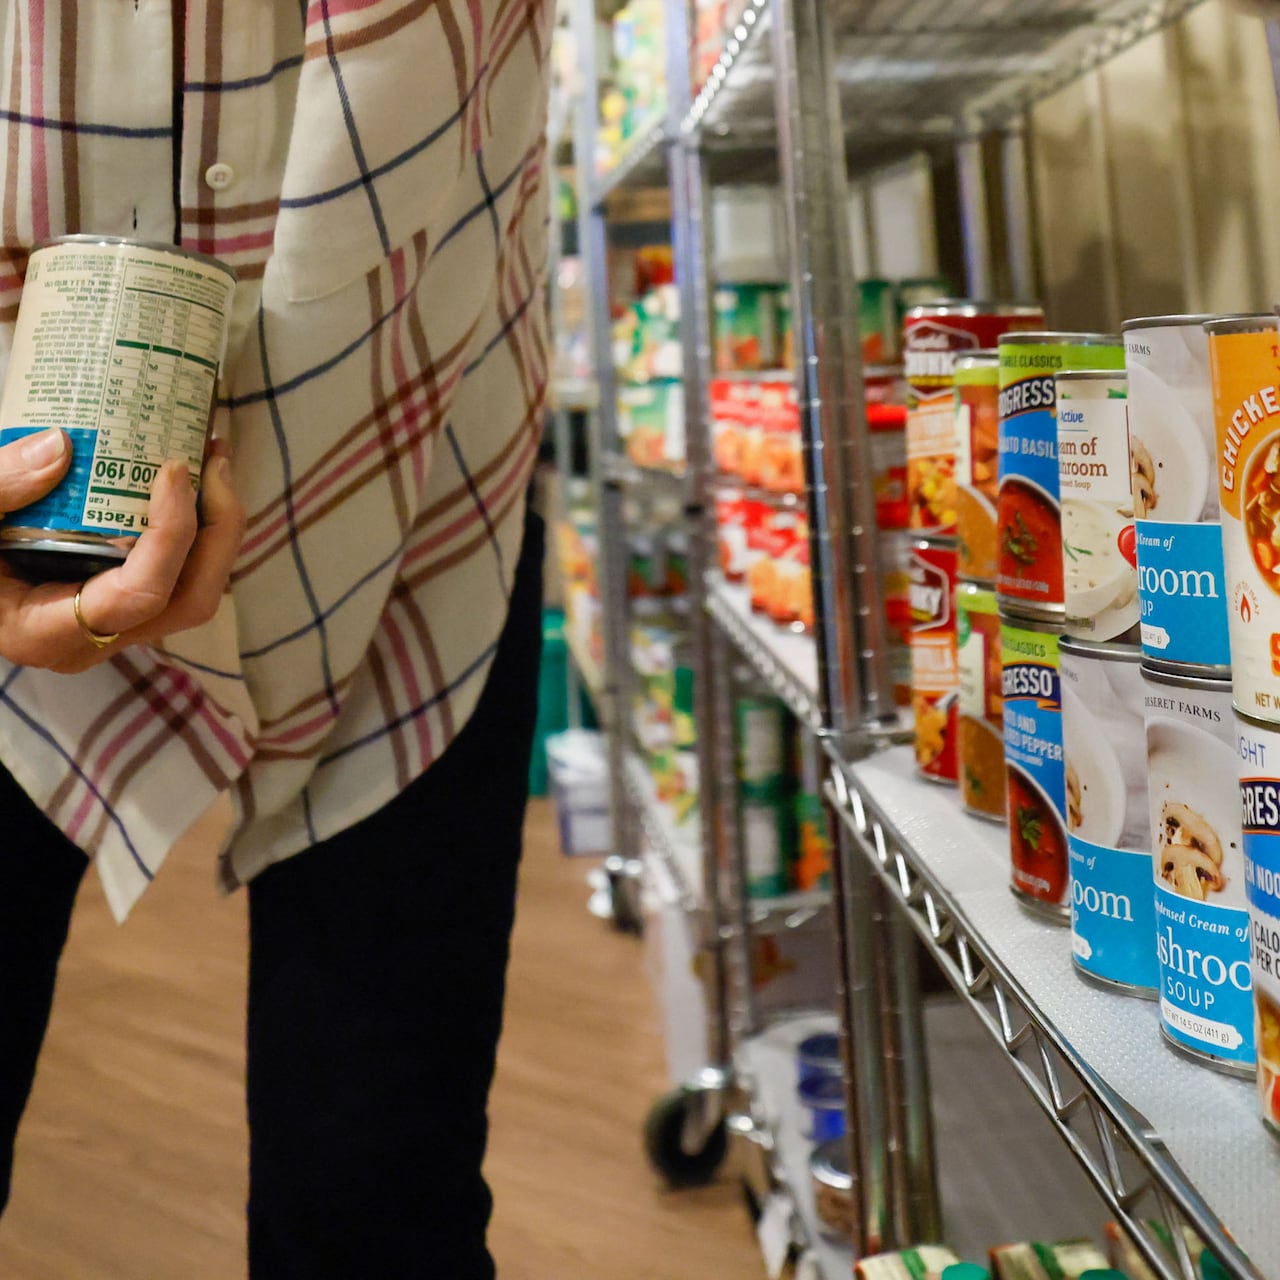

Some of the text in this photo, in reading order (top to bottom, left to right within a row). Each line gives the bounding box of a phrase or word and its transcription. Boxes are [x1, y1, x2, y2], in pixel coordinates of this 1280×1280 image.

[1020, 354, 1063, 369] CLASSICS
[1021, 437, 1058, 460] BASIL
[1080, 437, 1098, 457] of
[95, 460, 126, 480] 190
[89, 496, 104, 504] can
[87, 510, 134, 527] Facts
[1163, 535, 1175, 551] of
[1138, 565, 1219, 599] room
[1140, 600, 1154, 617] UP
[1255, 691, 1271, 709] NET
[1178, 702, 1221, 722] FARMS
[1154, 899, 1185, 925] ndensed
[1188, 913, 1230, 936] Cream
[1235, 921, 1249, 943] of
[1156, 925, 1253, 992] shroo
[1255, 948, 1274, 977] PER
[1167, 976, 1215, 1011] SOUP
[1179, 1014, 1193, 1031] 14.5
[1192, 1020, 1203, 1035] OZ
[1204, 1022, 1220, 1040] (411
